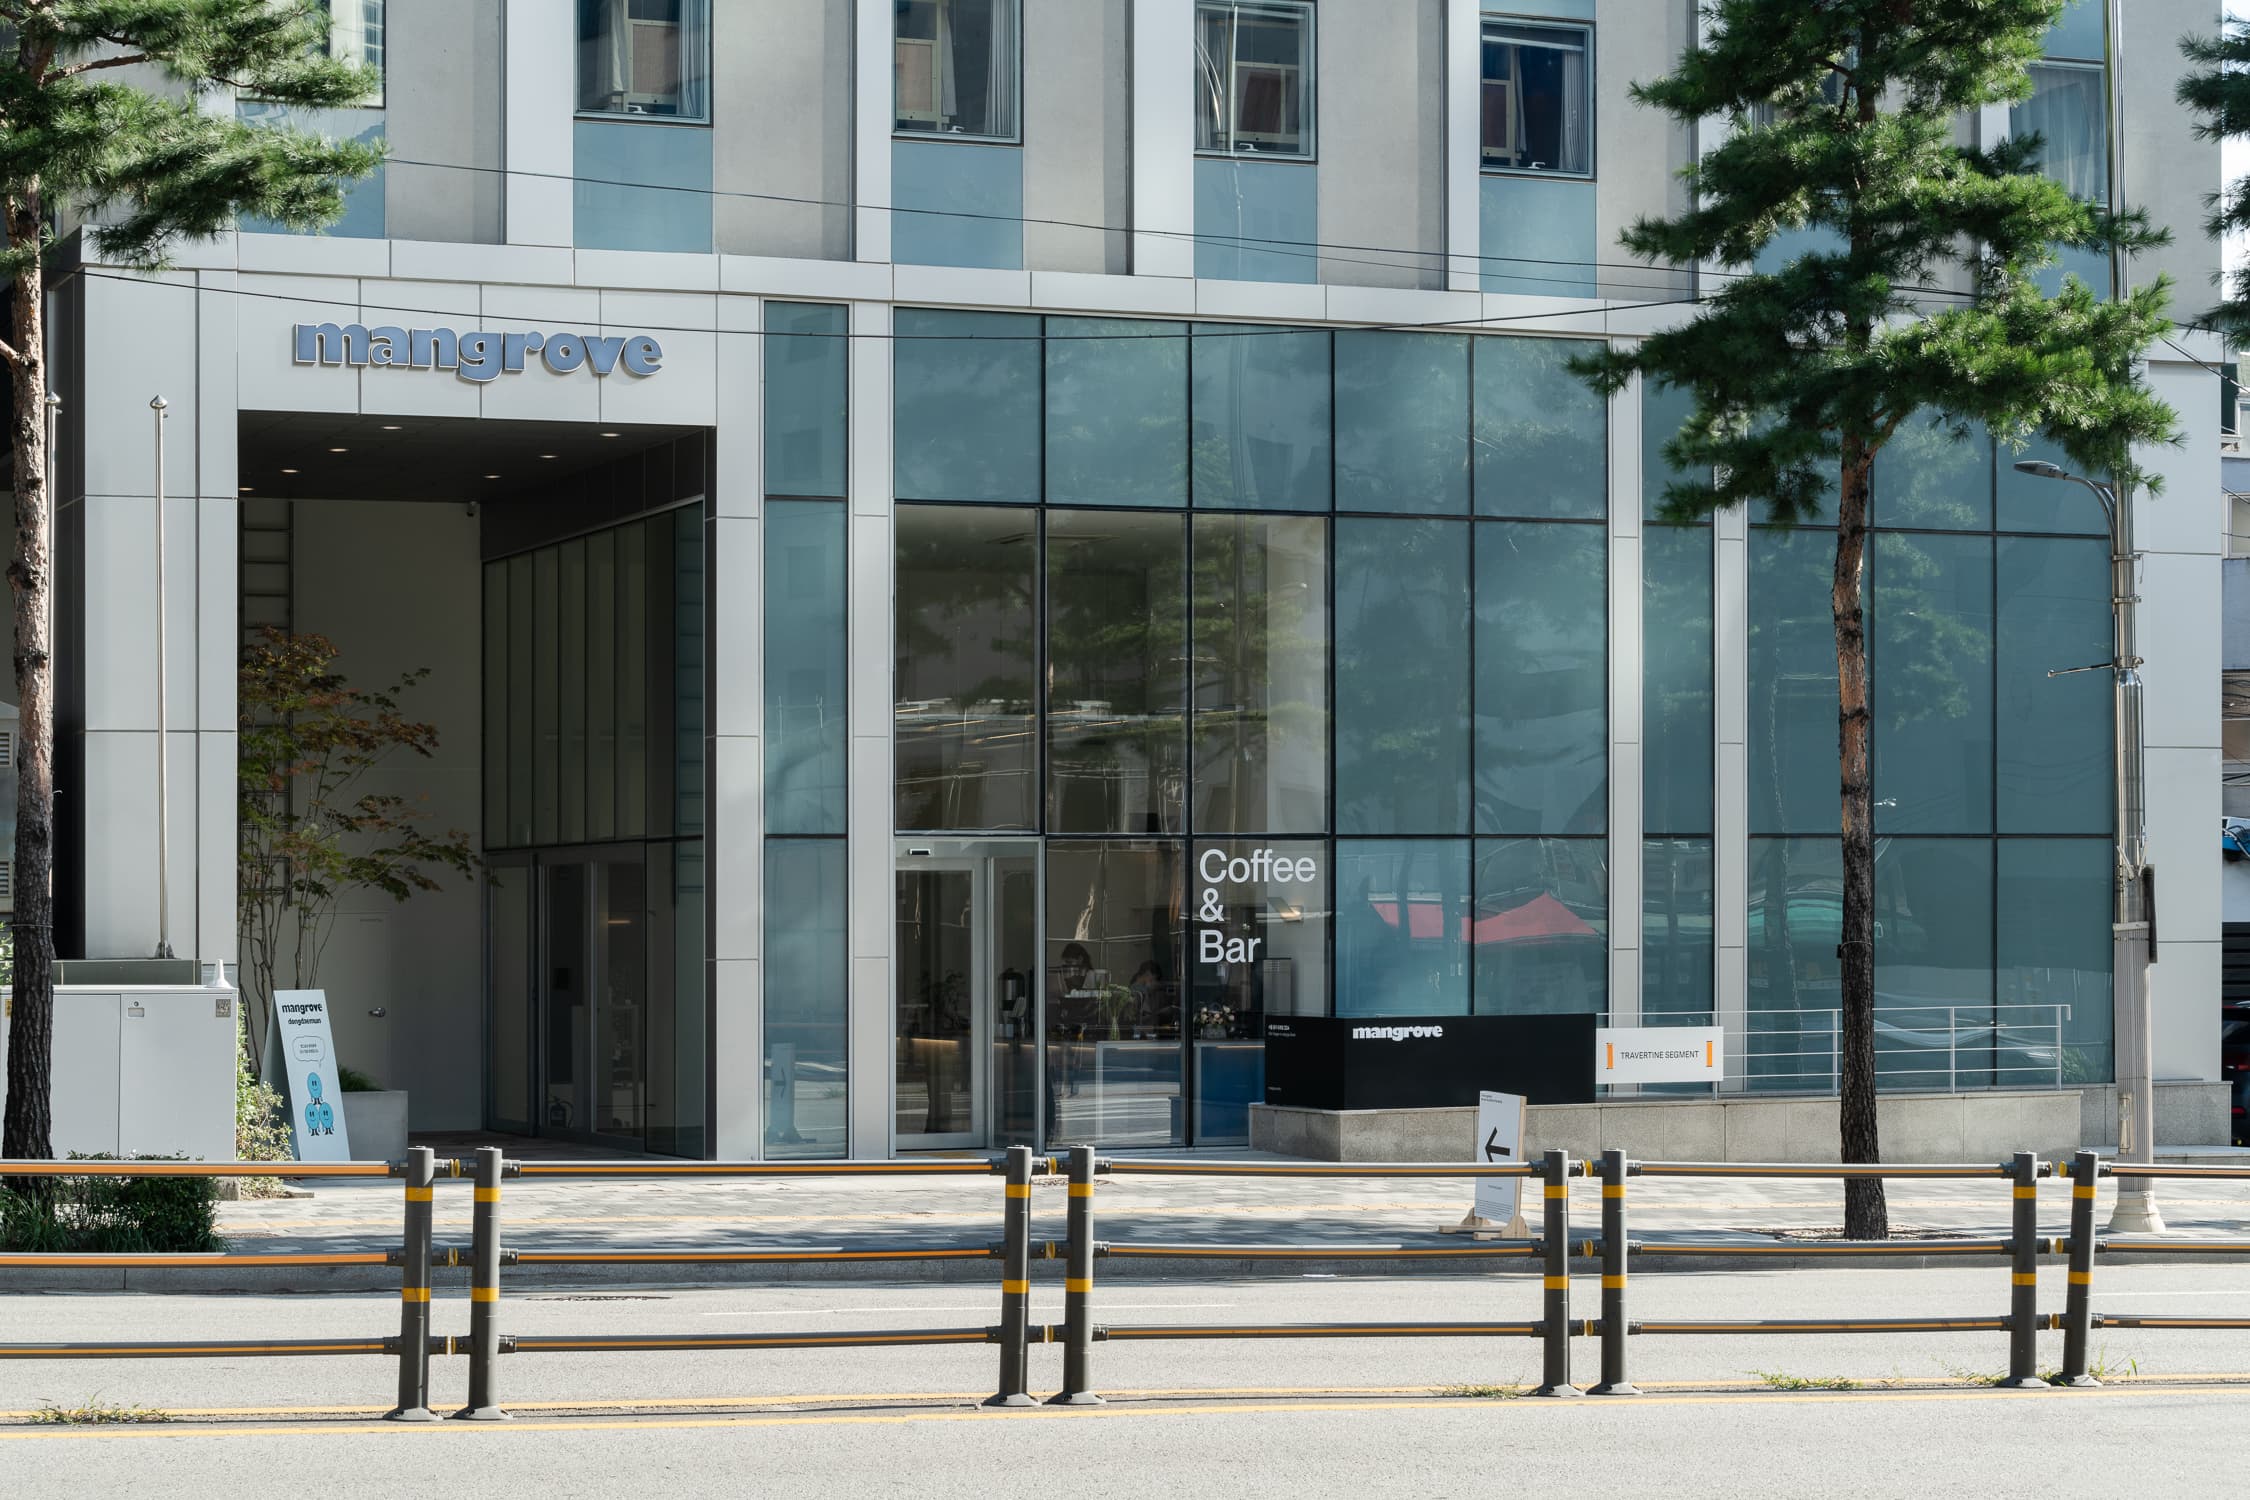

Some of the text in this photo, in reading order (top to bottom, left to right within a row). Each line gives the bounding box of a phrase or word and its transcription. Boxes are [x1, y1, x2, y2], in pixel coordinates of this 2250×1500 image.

[294, 322, 663, 382] mangrove
[1200, 848, 1316, 883] Coffee
[1200, 887, 1224, 922] &
[1200, 929, 1261, 963] Bar
[282, 1003, 323, 1014] mangrove
[1352, 1025, 1443, 1041] mangrove
[1621, 1050, 1699, 1060] TRAVERTINE SEGMENT
